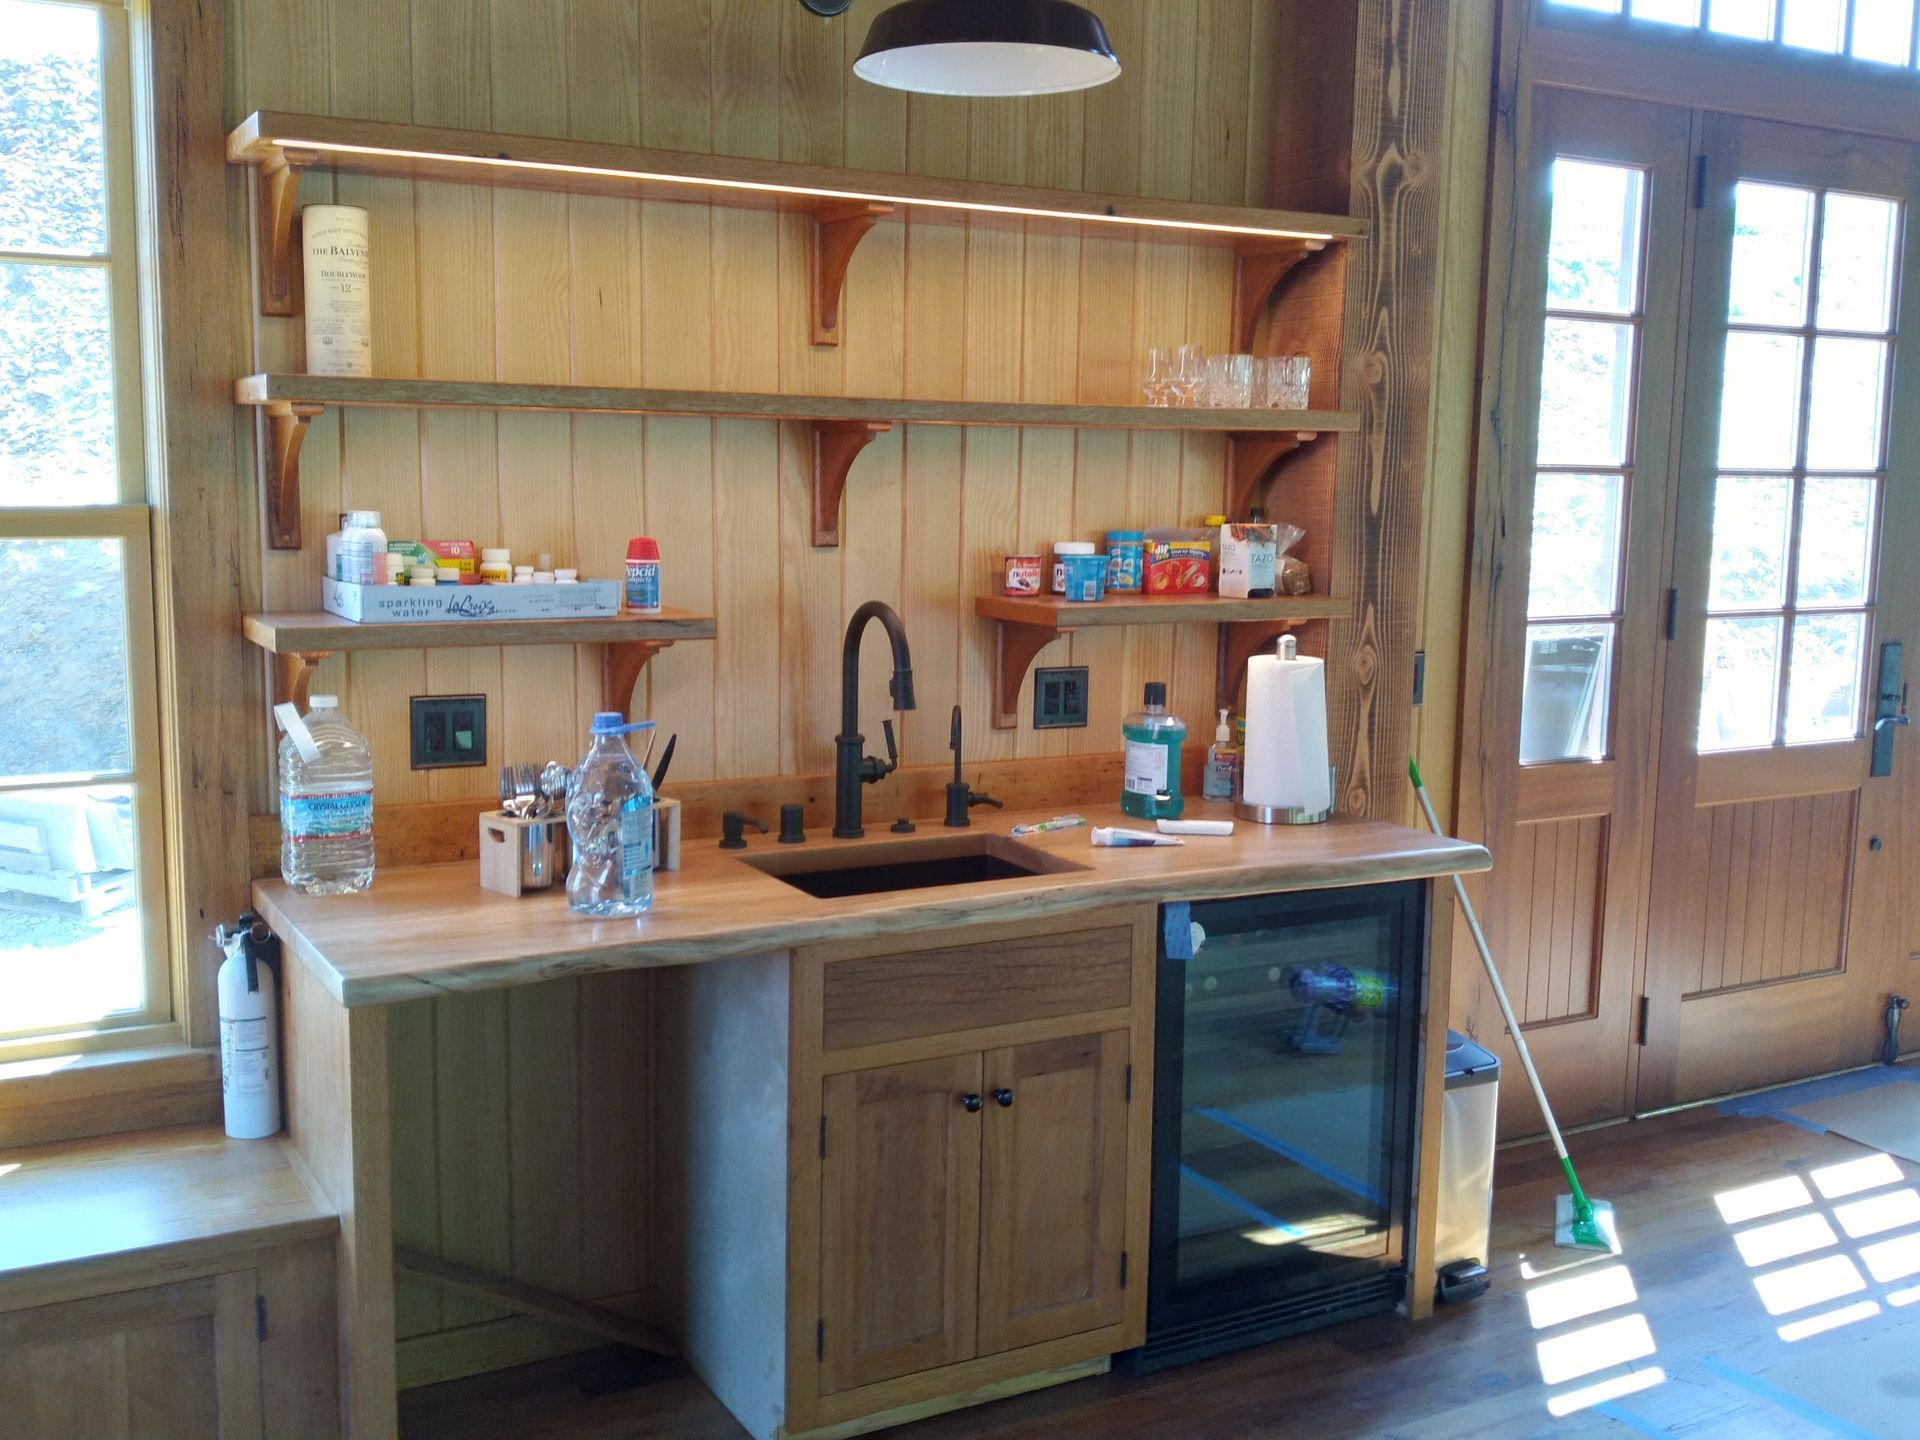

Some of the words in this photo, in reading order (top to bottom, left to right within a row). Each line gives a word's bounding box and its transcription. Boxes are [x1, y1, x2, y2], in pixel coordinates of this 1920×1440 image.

[1251, 553, 1273, 563] TAZO
[379, 597, 443, 610] sparkling
[392, 608, 430, 617] water
